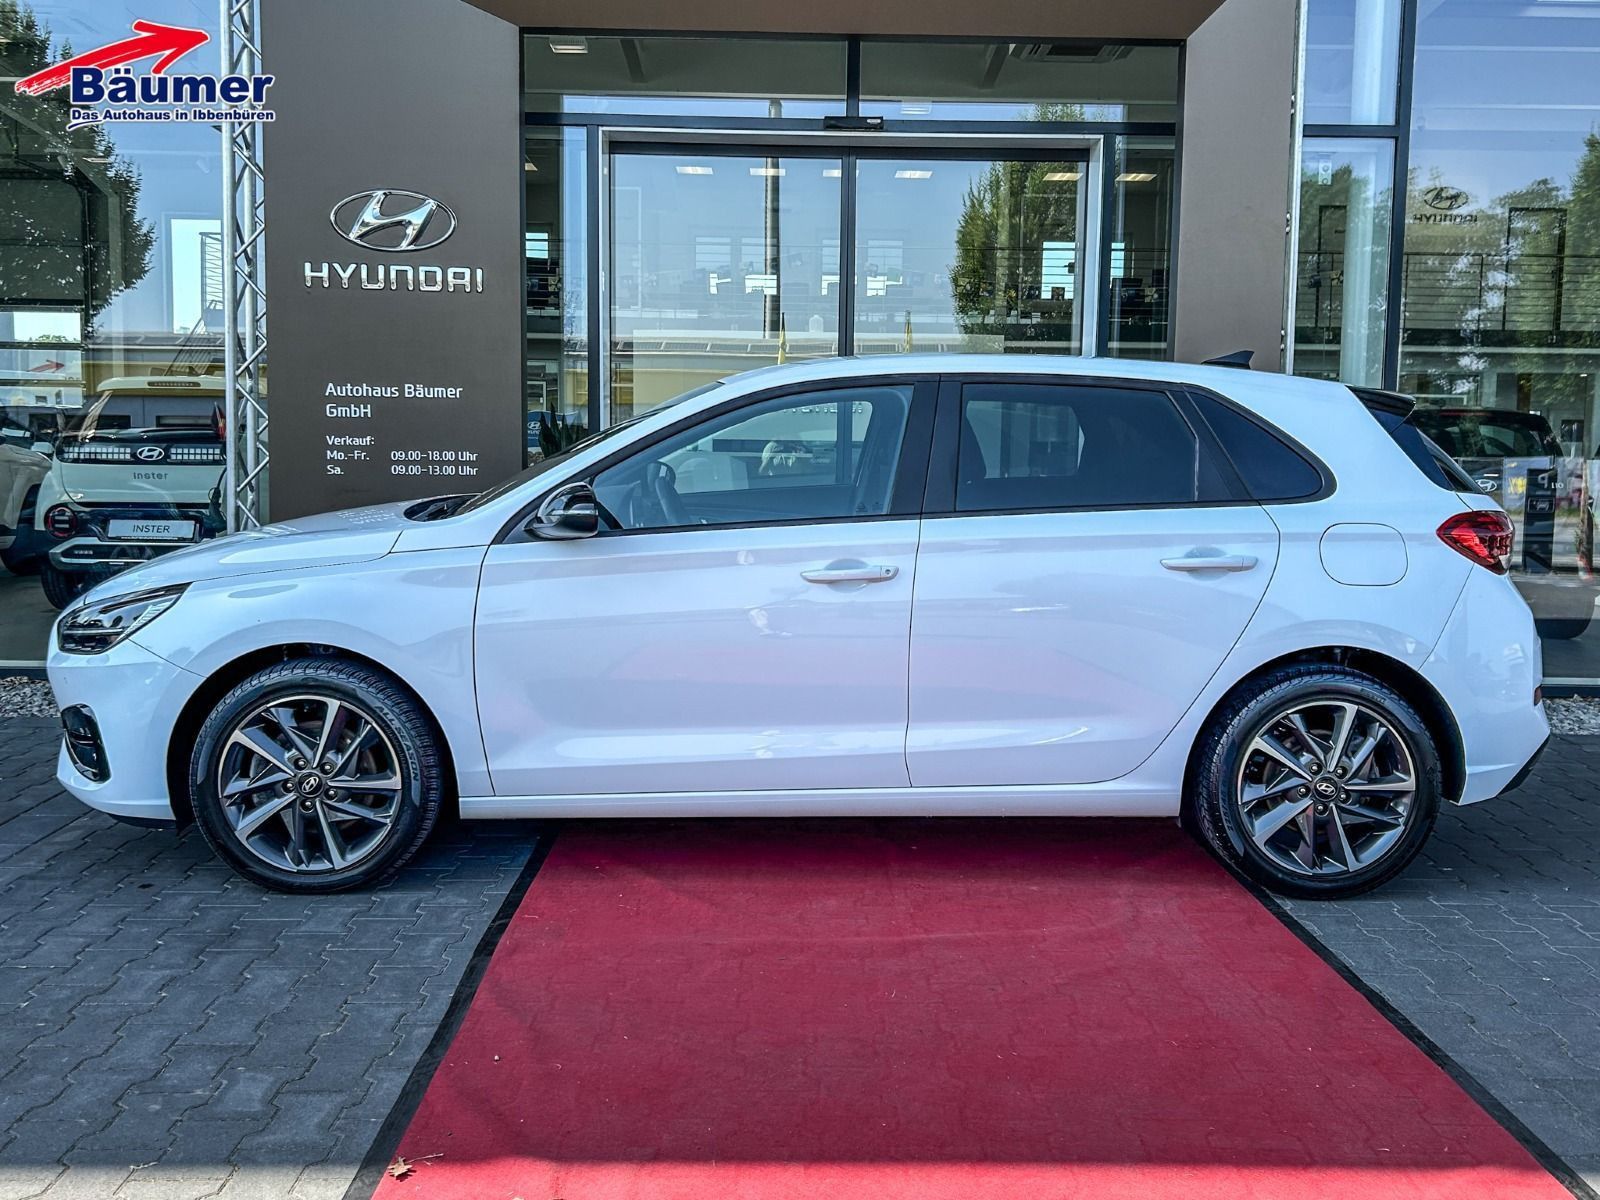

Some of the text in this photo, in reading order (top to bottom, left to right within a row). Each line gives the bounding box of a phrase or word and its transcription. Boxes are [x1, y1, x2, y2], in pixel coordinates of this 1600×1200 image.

[303, 261, 485, 293] HYUNDAI
[325, 382, 463, 400] Autohaus Bäumer
[325, 403, 372, 418] GmbH
[325, 435, 375, 447] Verkauf:
[326, 450, 479, 462] Mo.-Fr. 09.00-18.00 Uhr
[326, 464, 479, 476] Sa. 09.00-13.00 Uhr
[132, 524, 171, 533] INSTER
[374, 705, 420, 782] ALL SEASON
